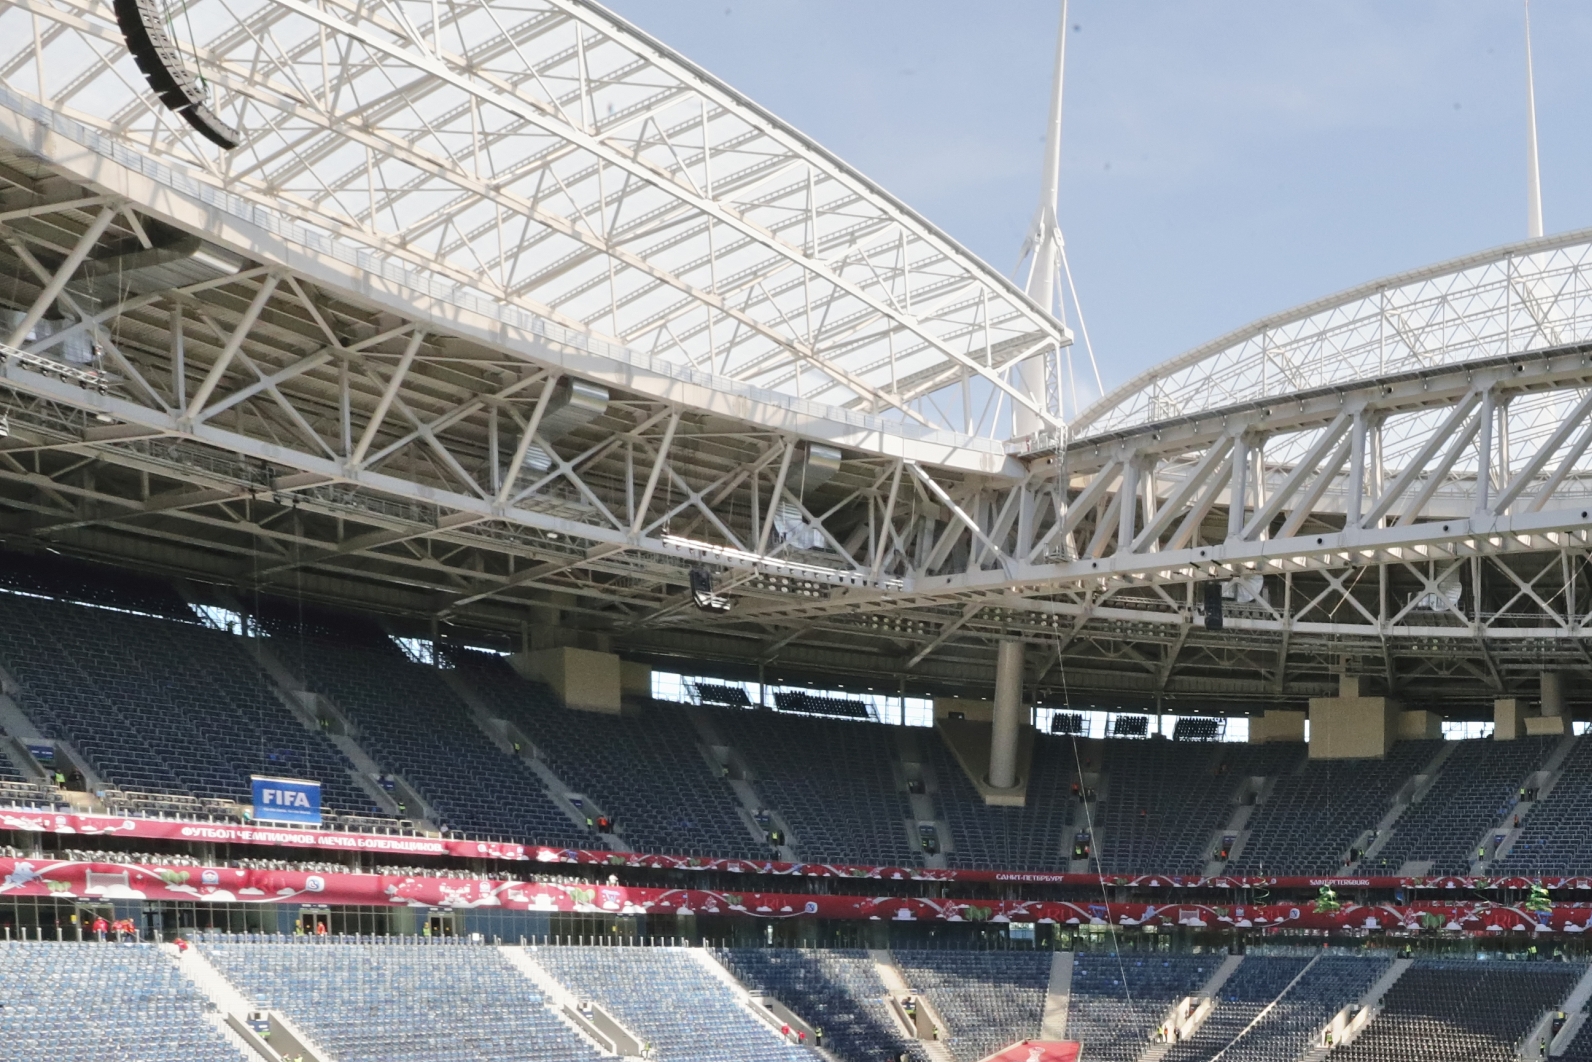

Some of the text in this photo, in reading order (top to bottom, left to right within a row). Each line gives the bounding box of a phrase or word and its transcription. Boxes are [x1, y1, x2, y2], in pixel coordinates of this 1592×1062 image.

[262, 788, 311, 808] FIFA
[181, 827, 236, 839] ФУТБОЛ
[318, 836, 356, 847] МЕЧТА
[996, 874, 1064, 882] САНКТ-ПЕТЕРБУРГ
